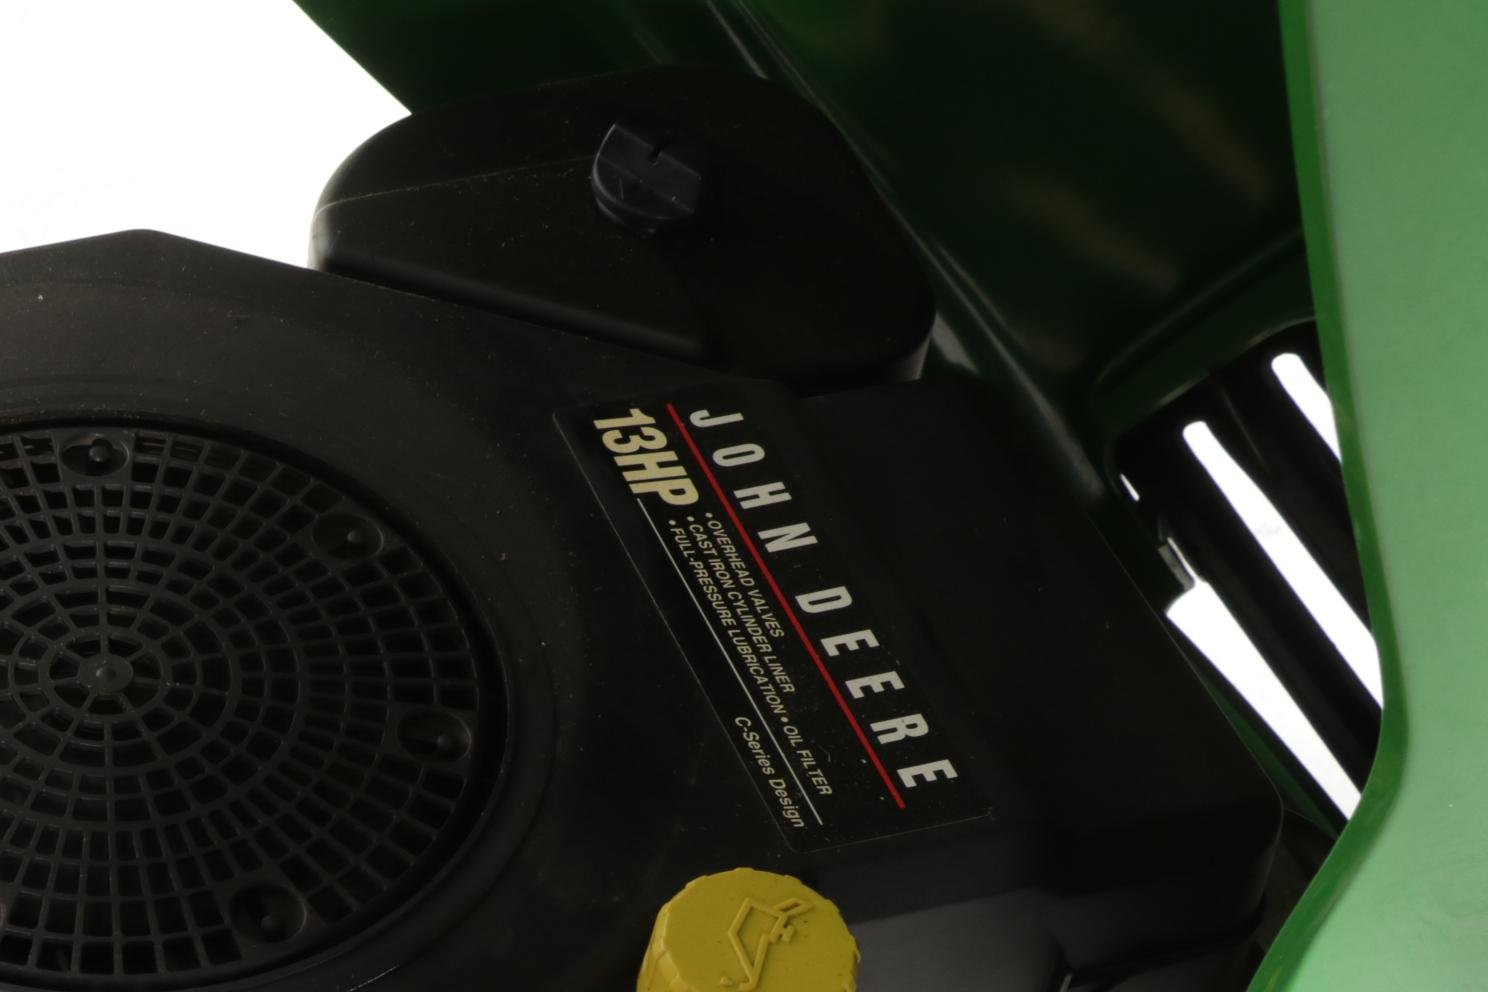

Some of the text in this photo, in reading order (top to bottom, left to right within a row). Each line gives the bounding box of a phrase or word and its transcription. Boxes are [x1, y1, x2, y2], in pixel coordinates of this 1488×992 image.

[593, 408, 699, 506] 13HP
[690, 410, 958, 788] JOHN DEERE
[690, 524, 795, 693] CAST IRON CYLINDER LINER
[709, 520, 784, 638] OVERHEAD VALVES
[671, 527, 832, 795] FULL-PRESSURE LUBRICATION OIL FILTER
[735, 716, 804, 828] C-Series Design
